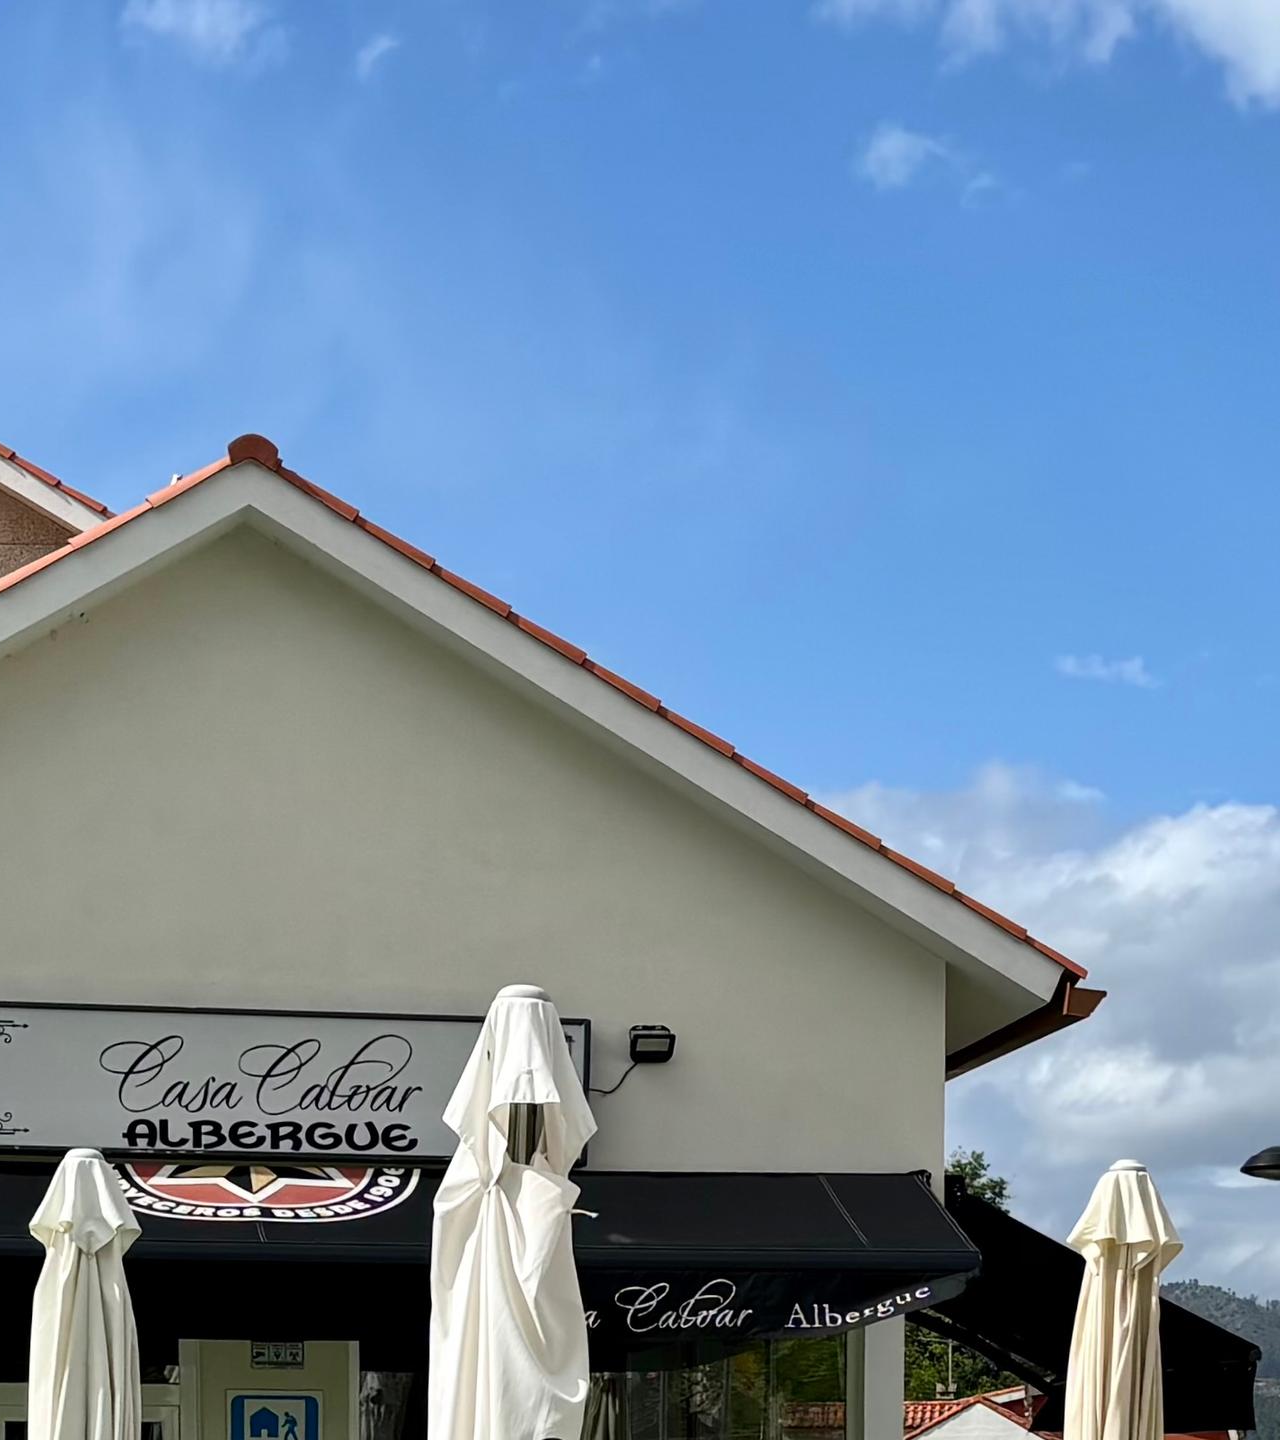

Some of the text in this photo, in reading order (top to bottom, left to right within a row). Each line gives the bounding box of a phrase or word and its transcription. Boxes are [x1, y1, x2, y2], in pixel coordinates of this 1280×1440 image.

[99, 1034, 243, 1113] Casa
[122, 1118, 418, 1151] ALBERGUE
[272, 1201, 370, 1218] DESDE
[784, 1286, 931, 1329] Albergue
